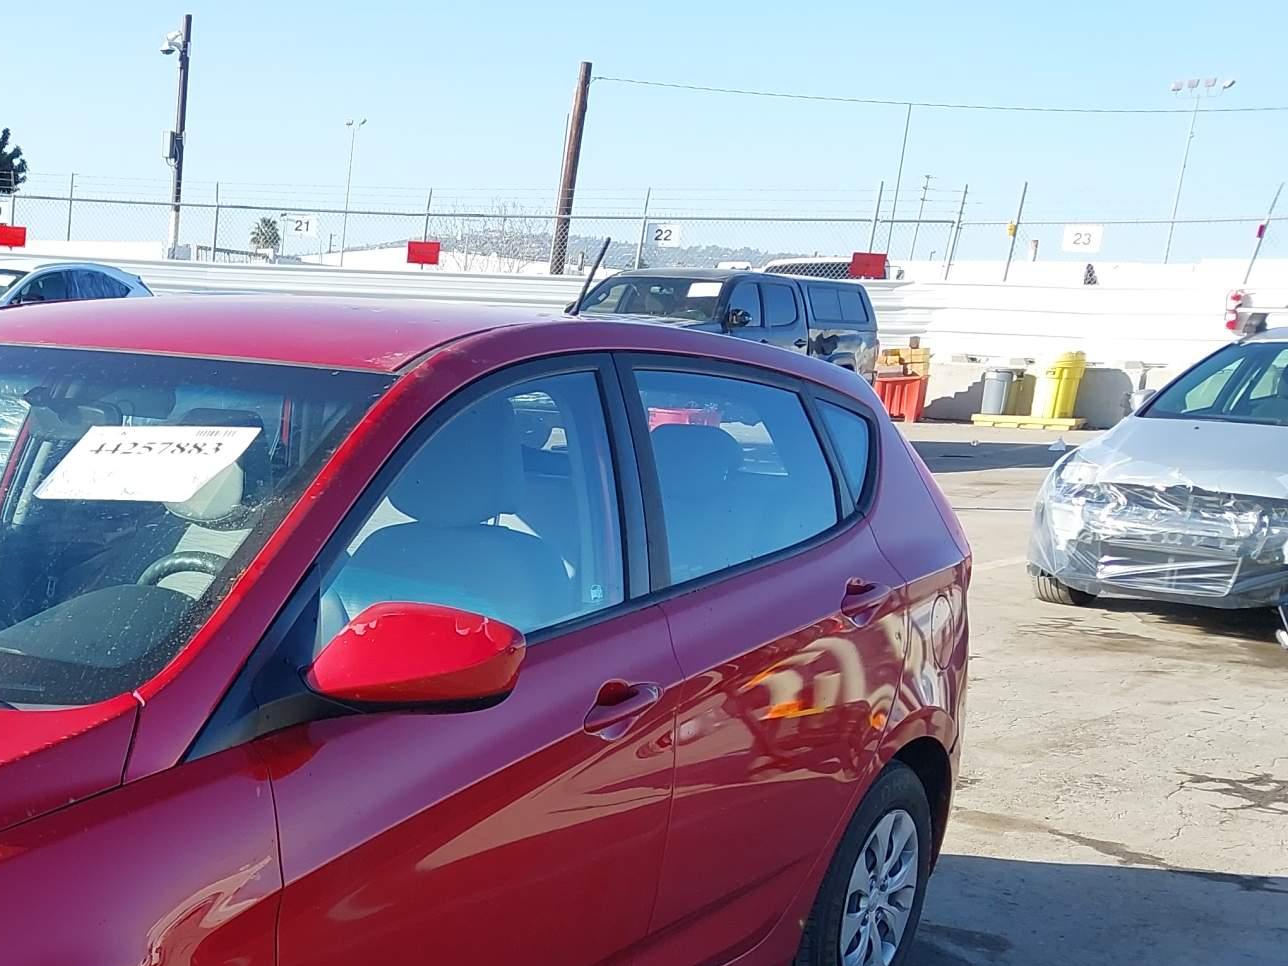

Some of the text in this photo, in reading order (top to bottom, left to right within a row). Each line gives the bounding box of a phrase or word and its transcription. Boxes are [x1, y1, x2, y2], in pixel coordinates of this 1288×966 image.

[294, 219, 310, 232] 21
[654, 228, 673, 241] 22
[1072, 232, 1092, 246] 23
[89, 441, 224, 455] 44257883
